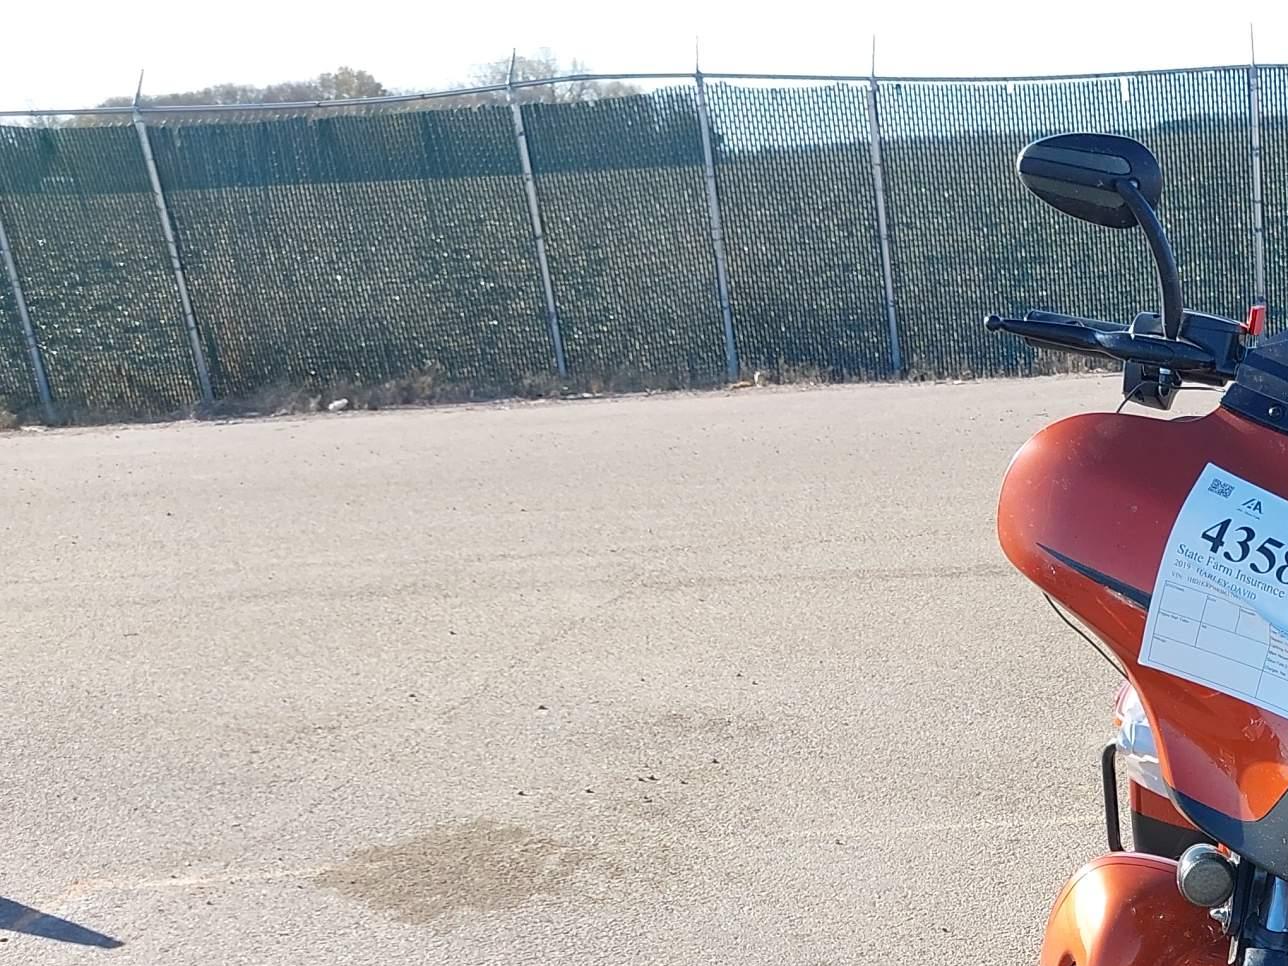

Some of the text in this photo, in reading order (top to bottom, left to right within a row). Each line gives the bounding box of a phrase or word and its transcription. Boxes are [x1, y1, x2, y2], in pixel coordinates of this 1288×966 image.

[1174, 558, 1192, 571] 2019
[1176, 543, 1203, 564] State
[1205, 555, 1234, 578] Farm
[1234, 568, 1286, 599] Insurance
